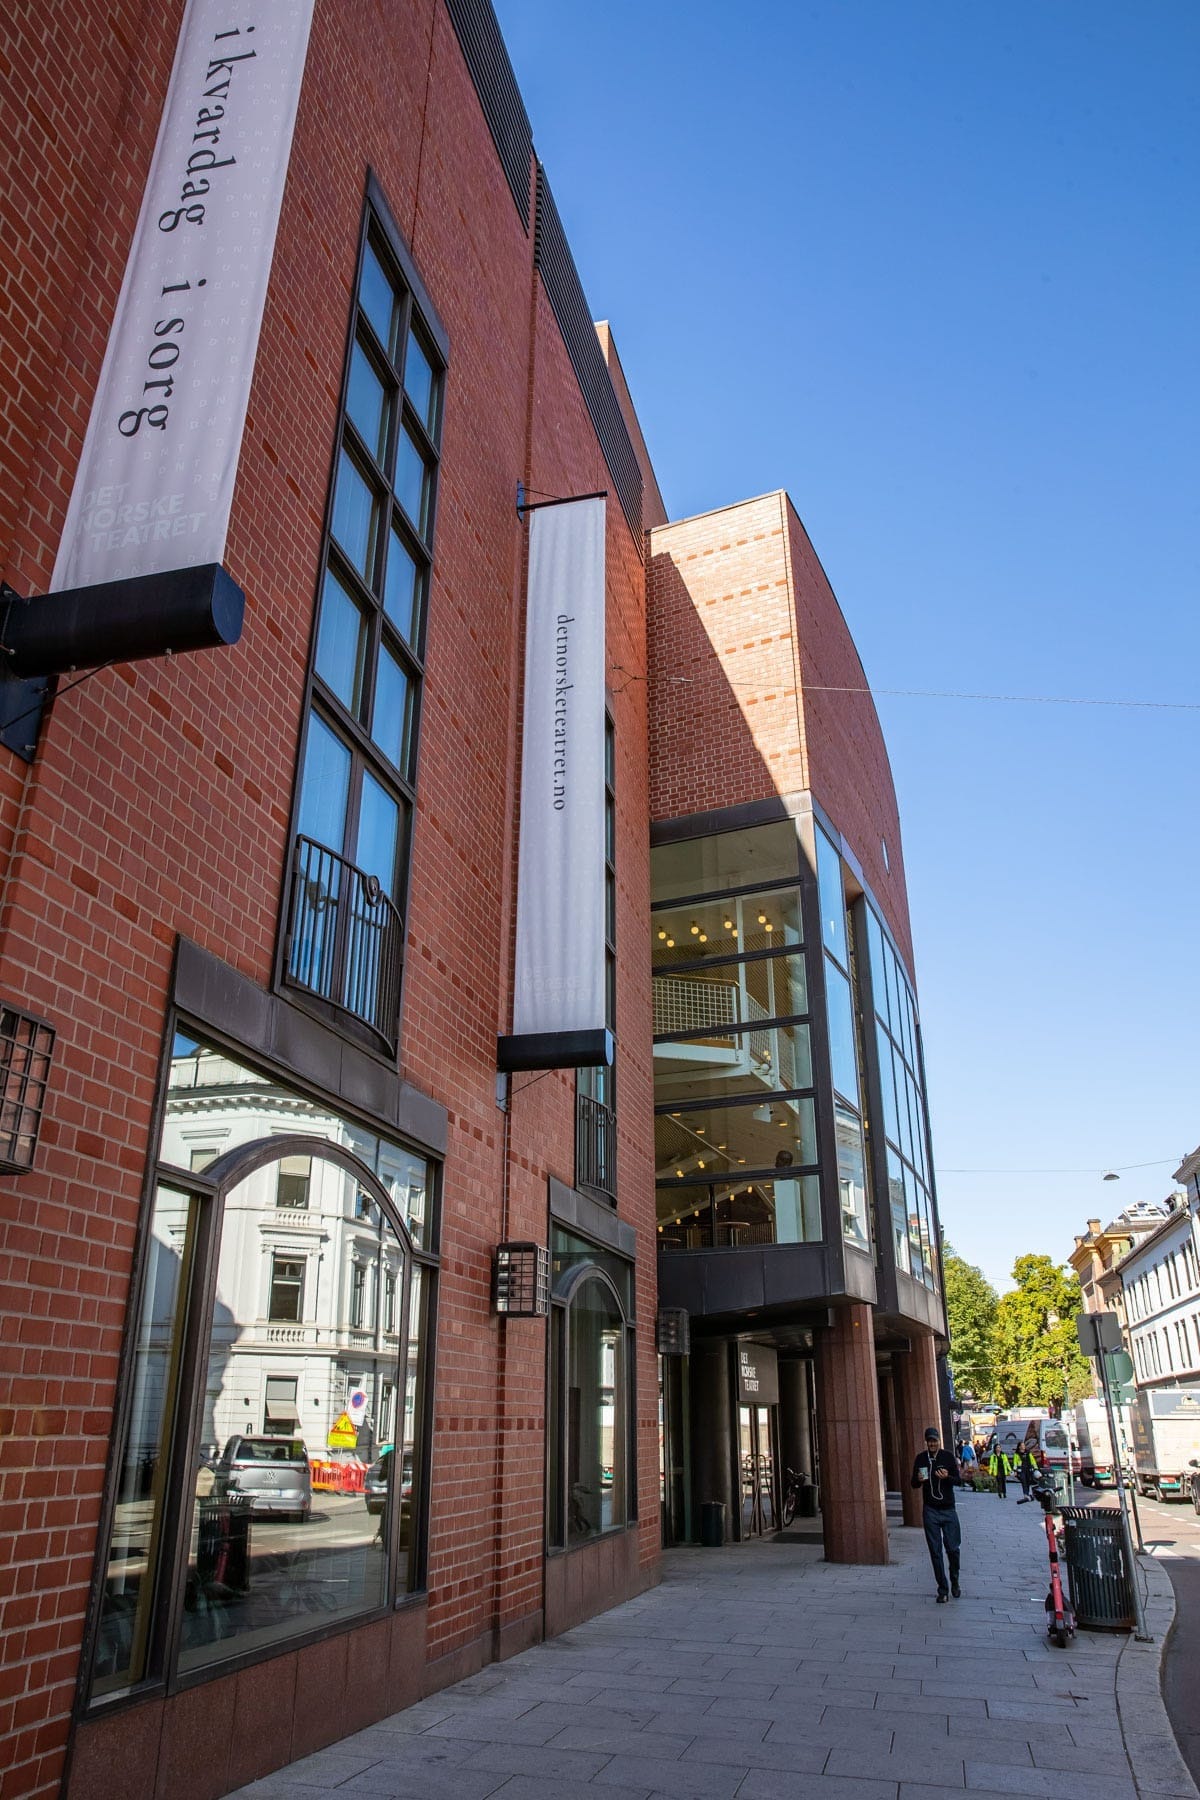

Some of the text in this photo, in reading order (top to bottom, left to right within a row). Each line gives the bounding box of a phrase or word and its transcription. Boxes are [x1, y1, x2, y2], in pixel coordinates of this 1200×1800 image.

[214, 26, 256, 42] i
[158, 49, 257, 233] kvardag
[161, 278, 207, 297] i
[117, 317, 185, 437] sorg
[79, 493, 185, 535] NORSKE
[83, 482, 130, 508] DET
[90, 512, 207, 553] TEATRET
[553, 613, 575, 811] detnorsketeatret.no
